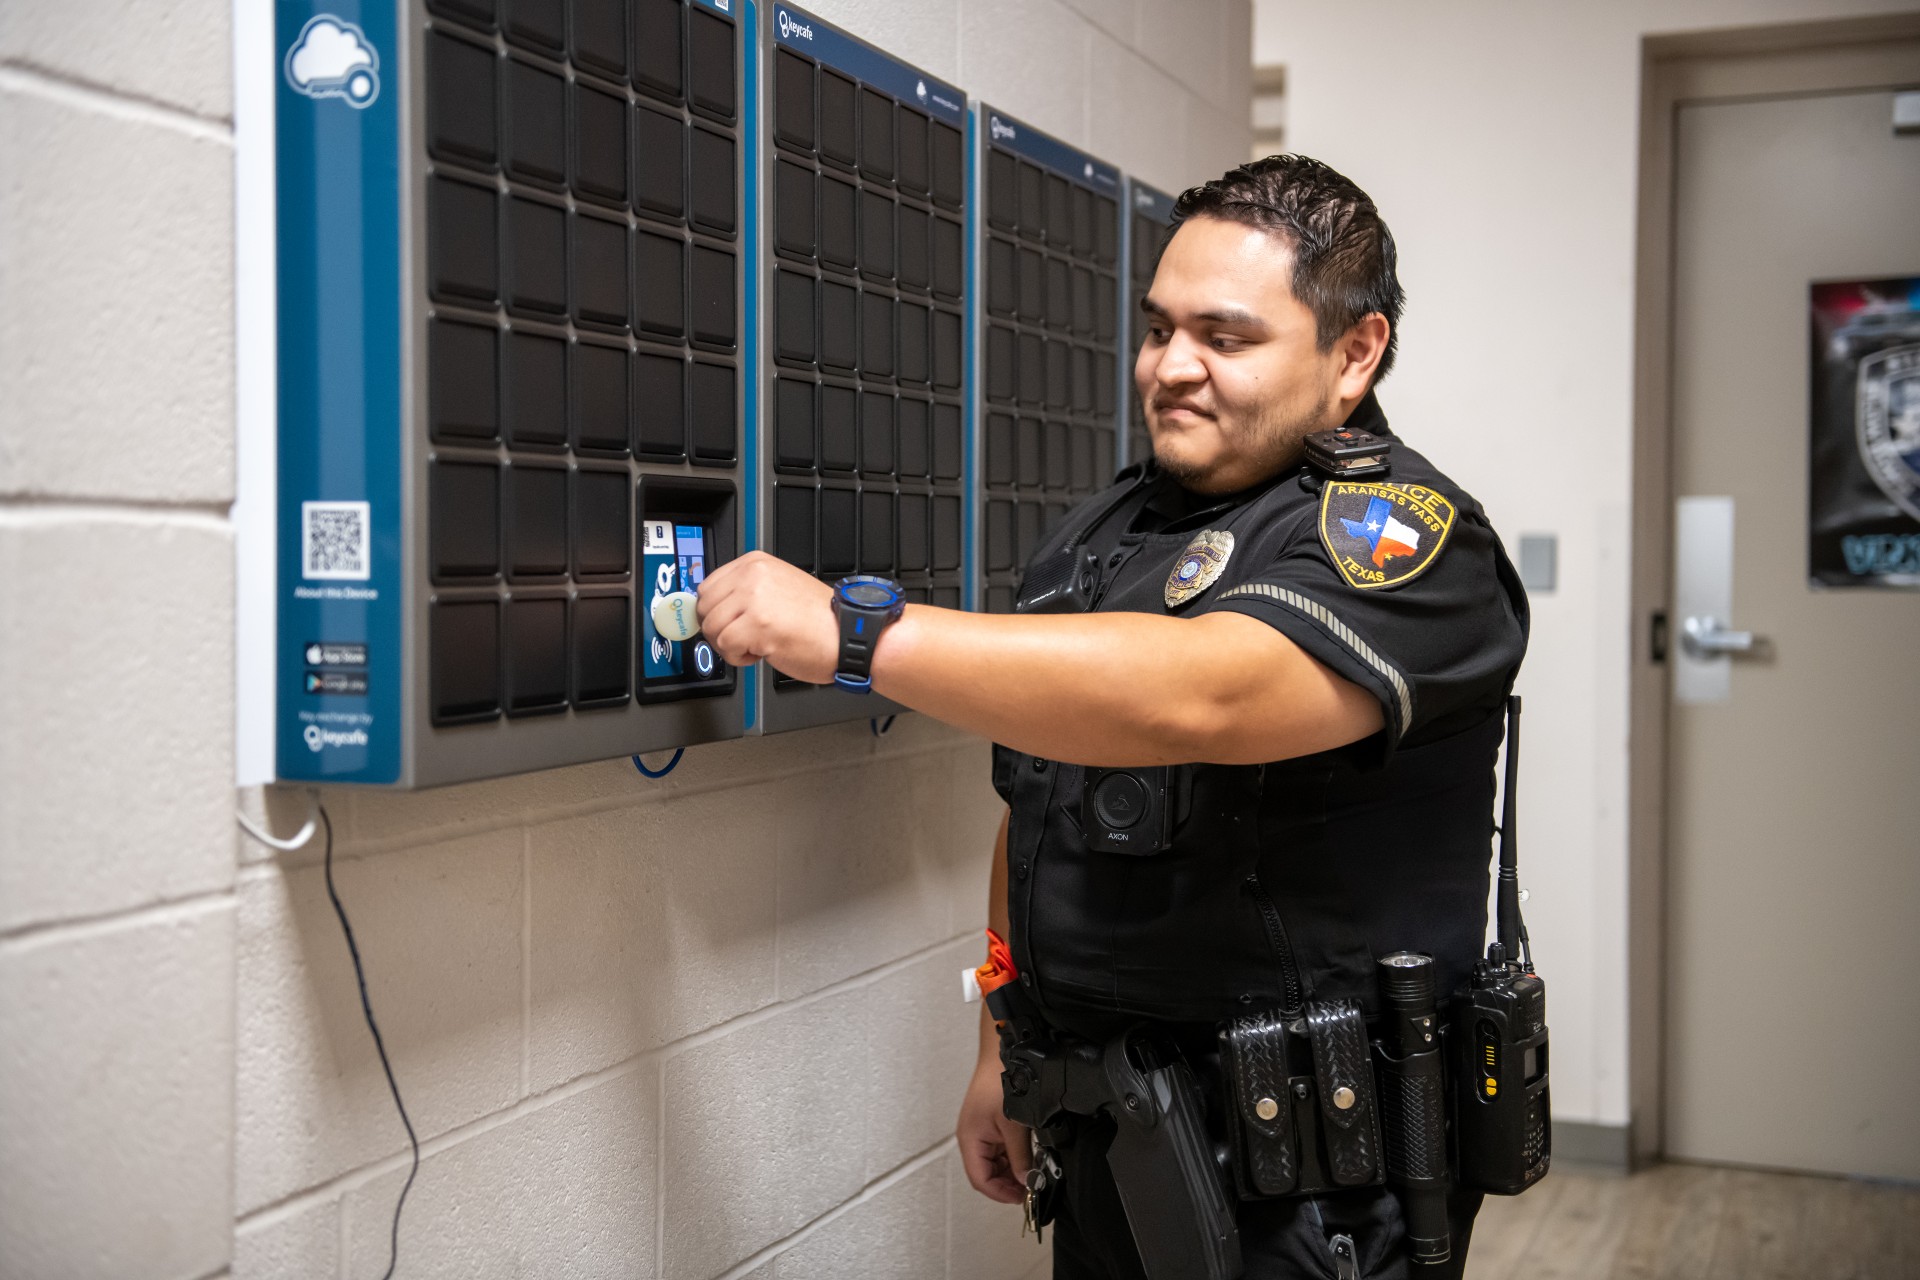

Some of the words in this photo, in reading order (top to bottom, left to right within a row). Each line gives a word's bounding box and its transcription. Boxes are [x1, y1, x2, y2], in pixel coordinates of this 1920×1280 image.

[788, 16, 813, 40] keycafe
[1338, 485, 1406, 505] ARANSAS
[1409, 504, 1441, 532] PASS
[1342, 555, 1385, 582] TEXAS
[1107, 832, 1129, 841] AXON
